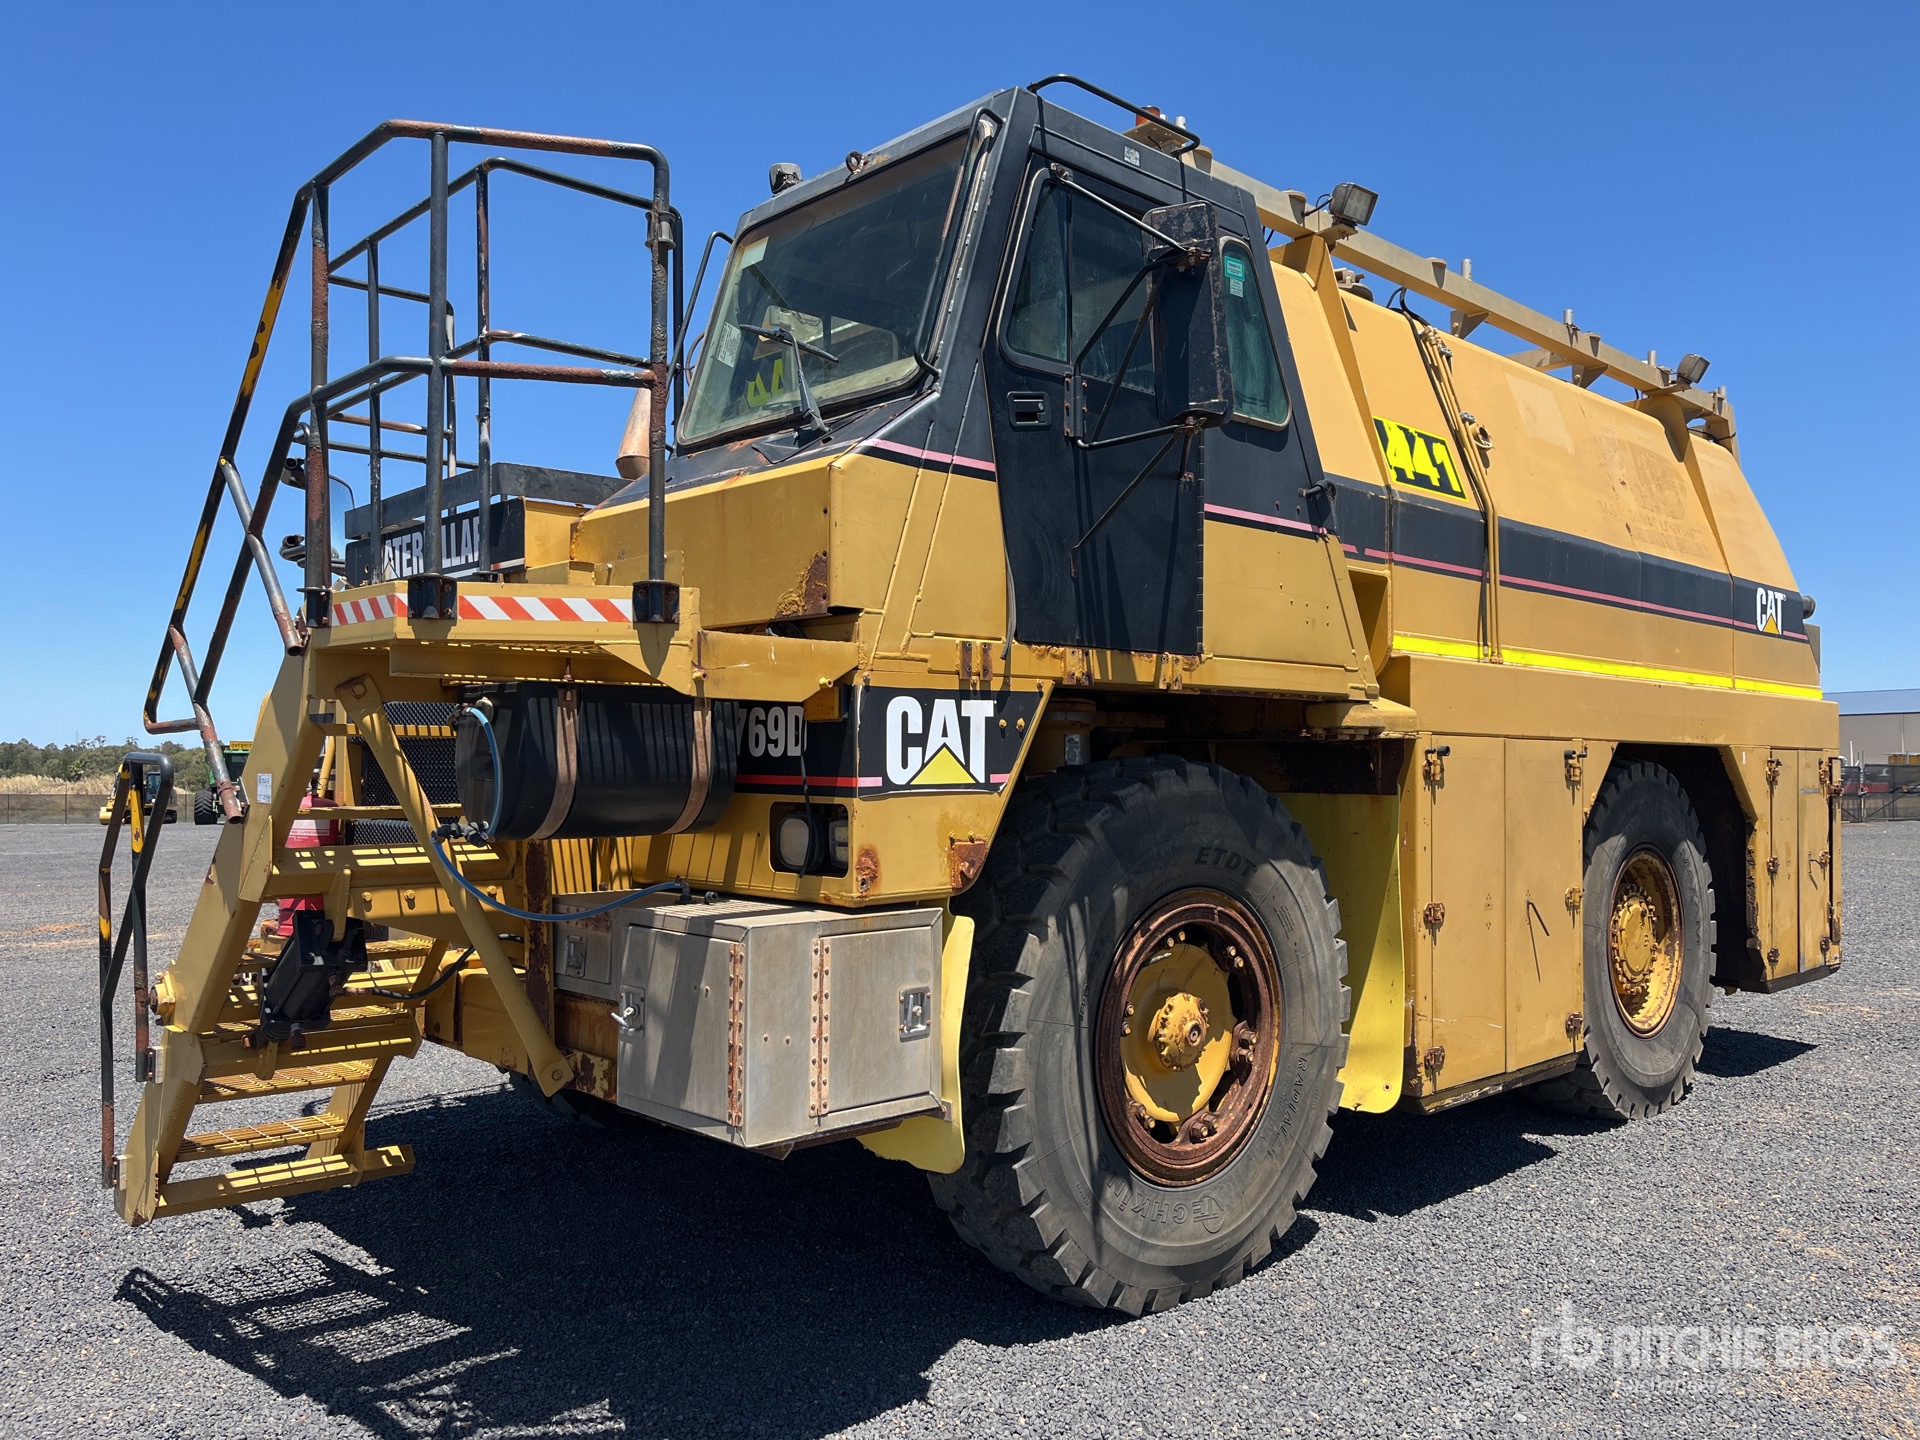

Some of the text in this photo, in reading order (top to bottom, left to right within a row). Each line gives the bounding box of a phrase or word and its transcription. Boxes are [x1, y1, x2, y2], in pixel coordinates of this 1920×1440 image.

[1756, 587, 1783, 635] CAT
[886, 695, 994, 785] CAT
[1194, 846, 1258, 877] ETDT
[1278, 1056, 1308, 1137] RADIAL
